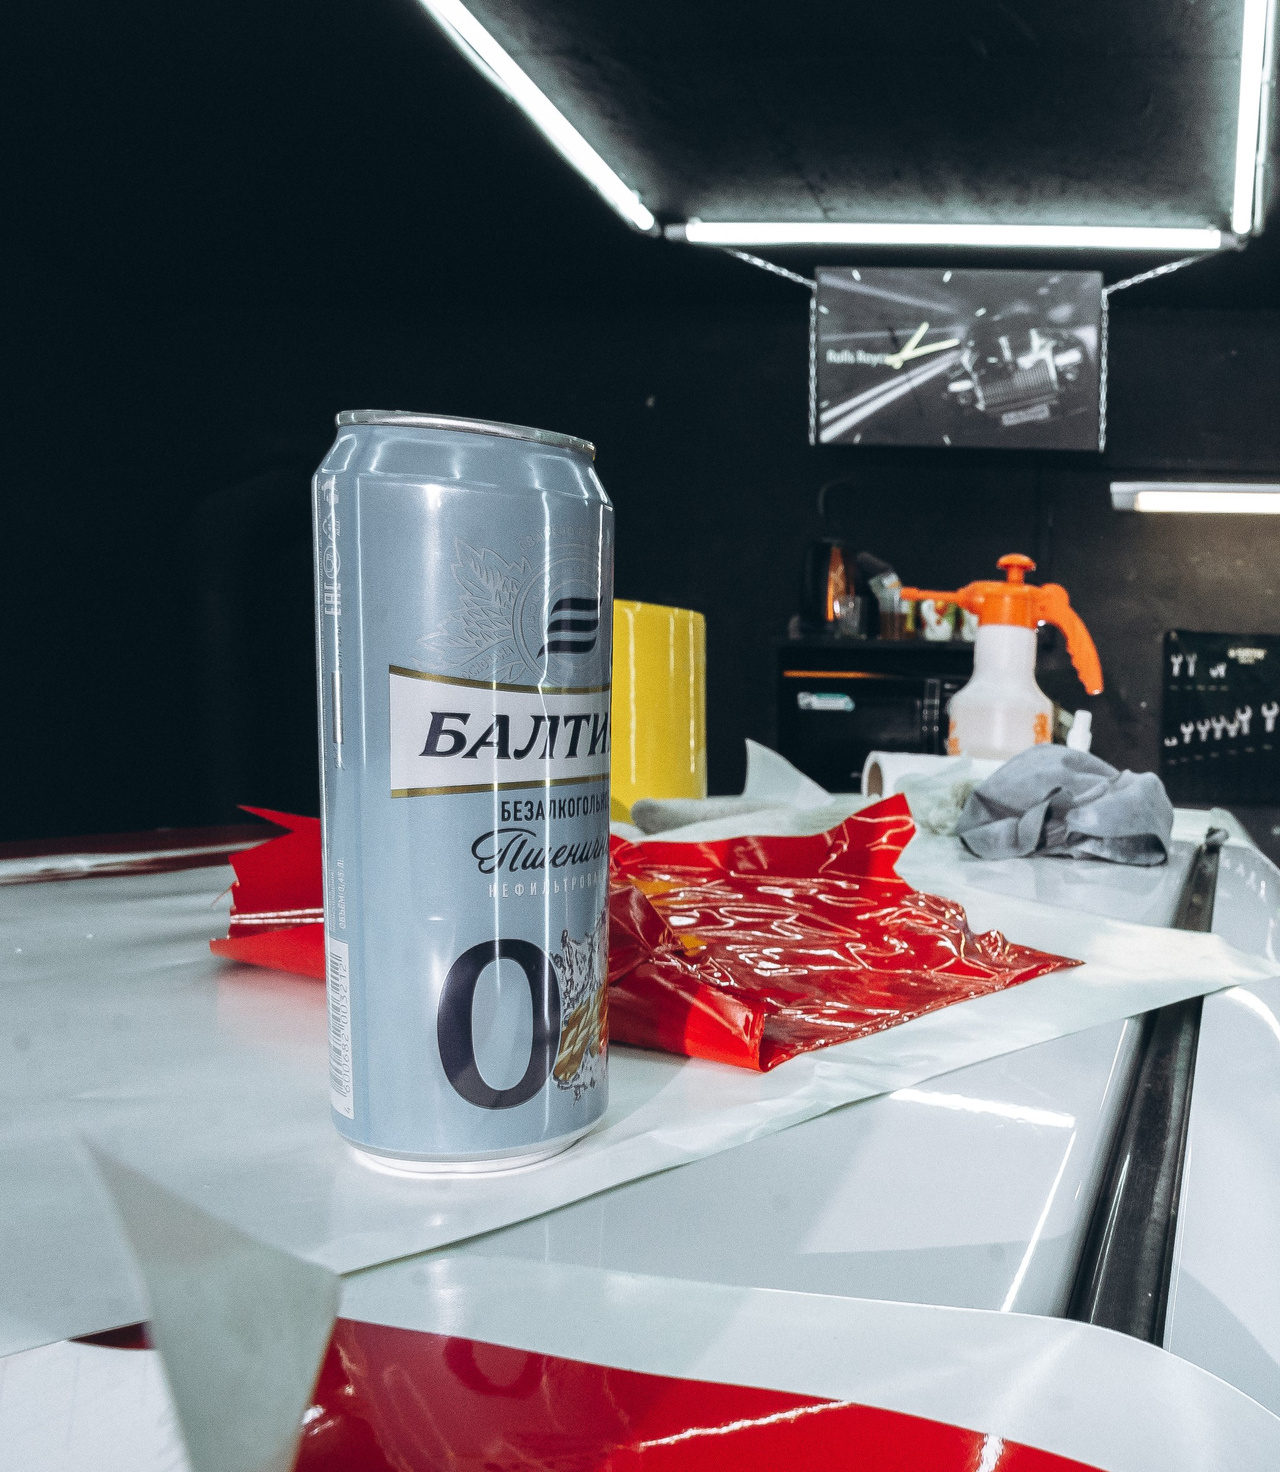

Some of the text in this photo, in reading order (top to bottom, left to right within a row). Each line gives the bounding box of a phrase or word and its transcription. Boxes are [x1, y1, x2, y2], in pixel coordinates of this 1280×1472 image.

[419, 711, 610, 760] БАЛТИ
[501, 791, 609, 822] БЕЗАЛКОГОЛЬН
[471, 828, 609, 874] Пшеничн
[489, 871, 604, 898] НЕФИЛЬТРОВА
[339, 963, 349, 1025] 003212
[437, 938, 561, 1110] 0
[341, 1032, 351, 1094] 600682
